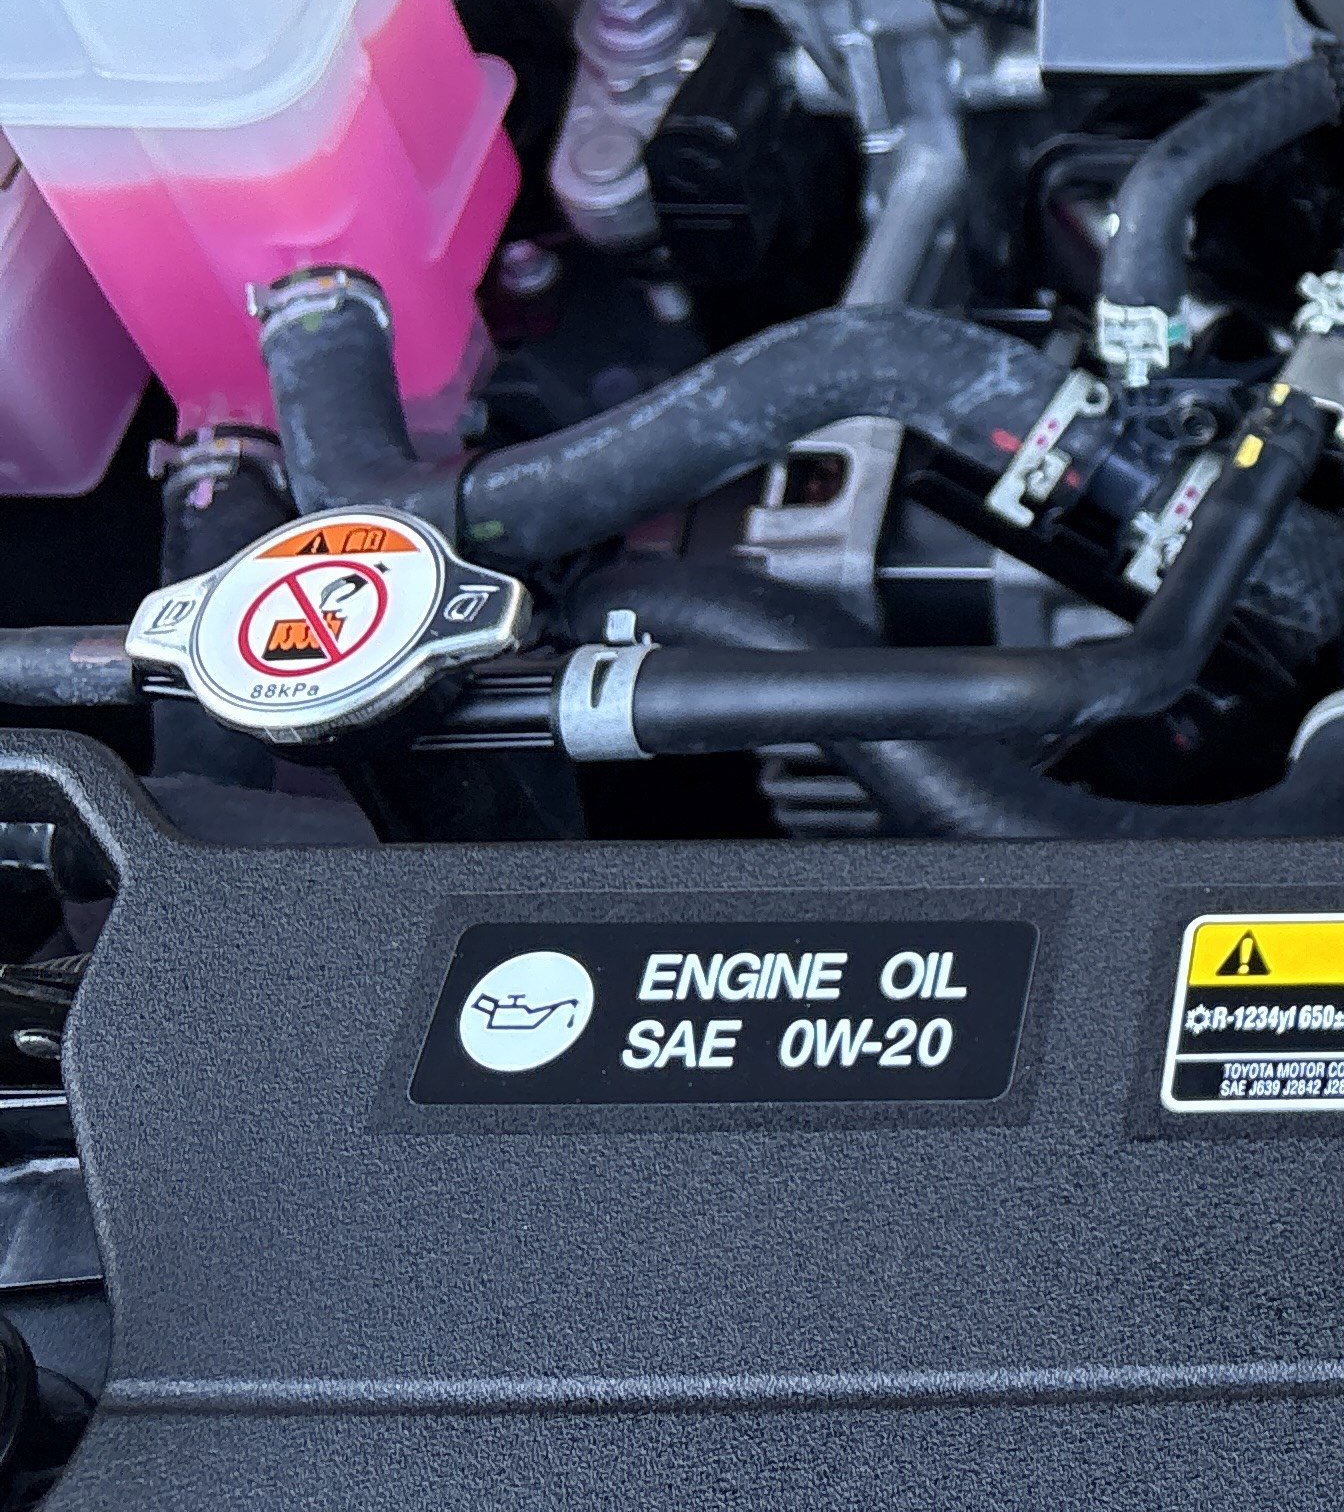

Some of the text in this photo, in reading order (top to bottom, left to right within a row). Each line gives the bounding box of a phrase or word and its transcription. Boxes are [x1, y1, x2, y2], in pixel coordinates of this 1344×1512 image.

[250, 683, 320, 700] 88kPa
[637, 951, 967, 1001] ENGINE OIL
[1212, 1004, 1297, 1034] R-1234yf
[621, 1018, 953, 1070] SAE 0W-20
[1223, 1062, 1274, 1079] TOYOTA
[1276, 1062, 1325, 1079] MOTOR
[1220, 1080, 1246, 1097] SAE
[1248, 1079, 1280, 1097] J639
[1283, 1079, 1321, 1096] J2842
